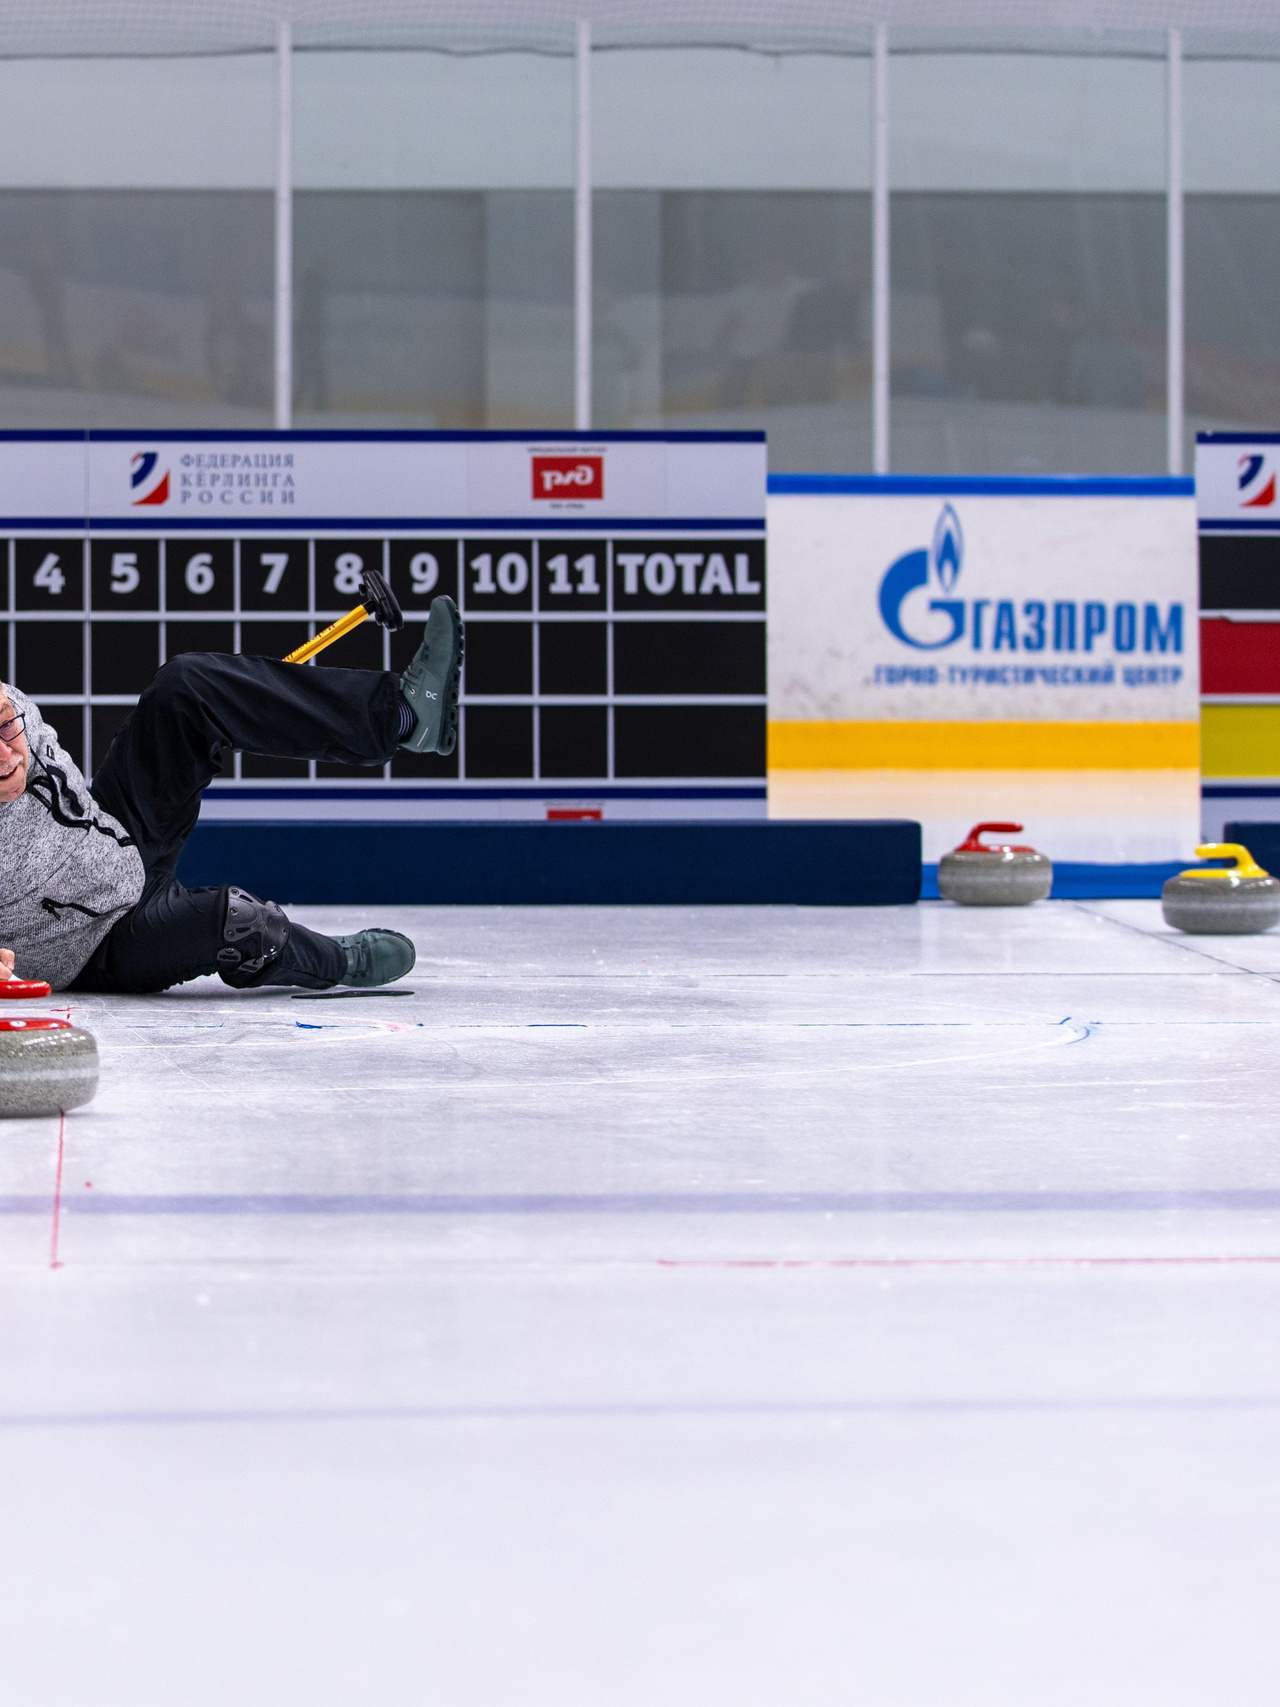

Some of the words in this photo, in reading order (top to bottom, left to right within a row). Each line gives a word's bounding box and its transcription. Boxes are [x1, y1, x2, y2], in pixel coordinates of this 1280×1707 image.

[180, 453, 295, 469] ФЕДЕРАЦИЯ
[180, 469, 296, 488] КЁРЛИНГА
[180, 489, 295, 506] РОССИИ
[34, 553, 65, 594] 4
[110, 552, 140, 594] 5
[185, 553, 215, 595] 6
[260, 553, 289, 594] 7
[334, 553, 364, 595] 8
[410, 553, 439, 595] 9
[470, 553, 529, 595] 10
[546, 554, 600, 594] 11
[617, 553, 762, 595] TOTAL
[972, 599, 1184, 654] ГАЗПРОМ
